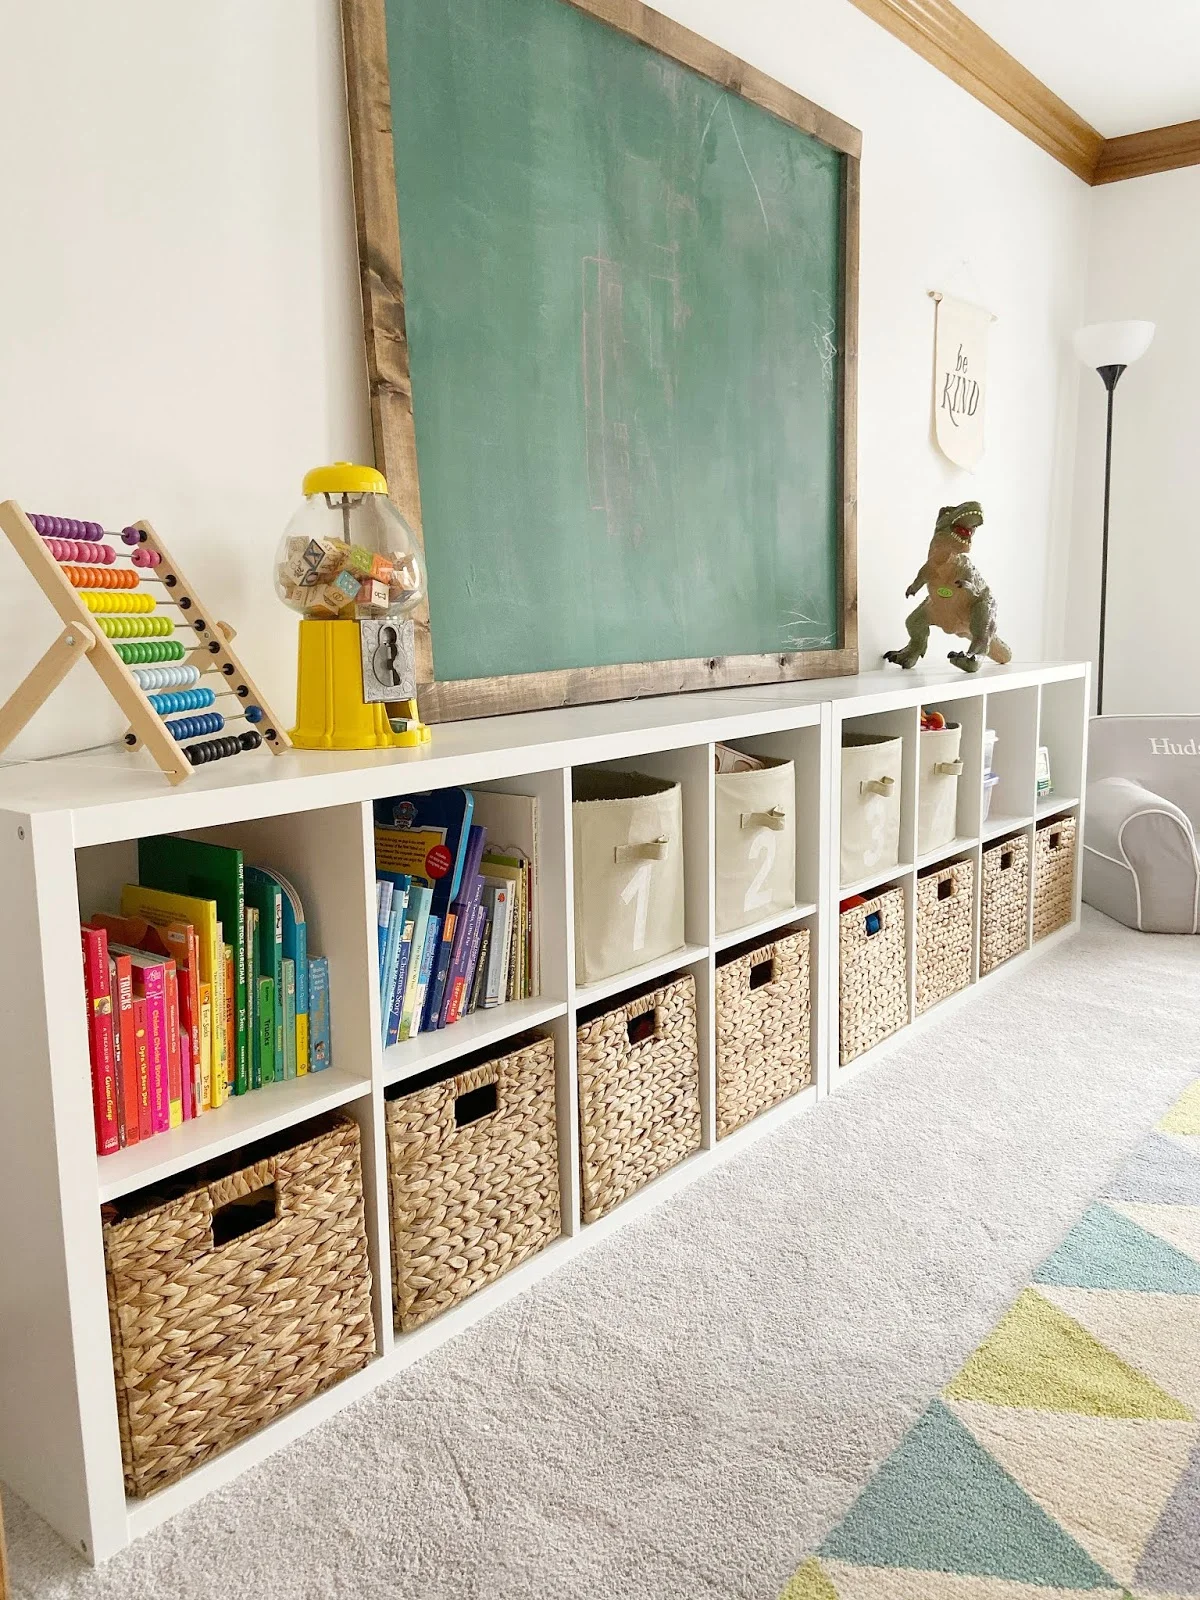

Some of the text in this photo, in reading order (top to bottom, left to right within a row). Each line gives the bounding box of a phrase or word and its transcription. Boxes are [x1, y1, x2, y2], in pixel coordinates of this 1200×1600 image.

[955, 343, 968, 374] be
[941, 372, 980, 427] KIND
[863, 797, 885, 867] 3
[744, 831, 776, 913] 2
[620, 863, 652, 952] 1
[398, 956, 408, 996] Christmas
[478, 950, 487, 972] Babies
[120, 975, 132, 1011] TRUCKS
[393, 995, 402, 1018] Story
[450, 1000, 458, 1017] tales
